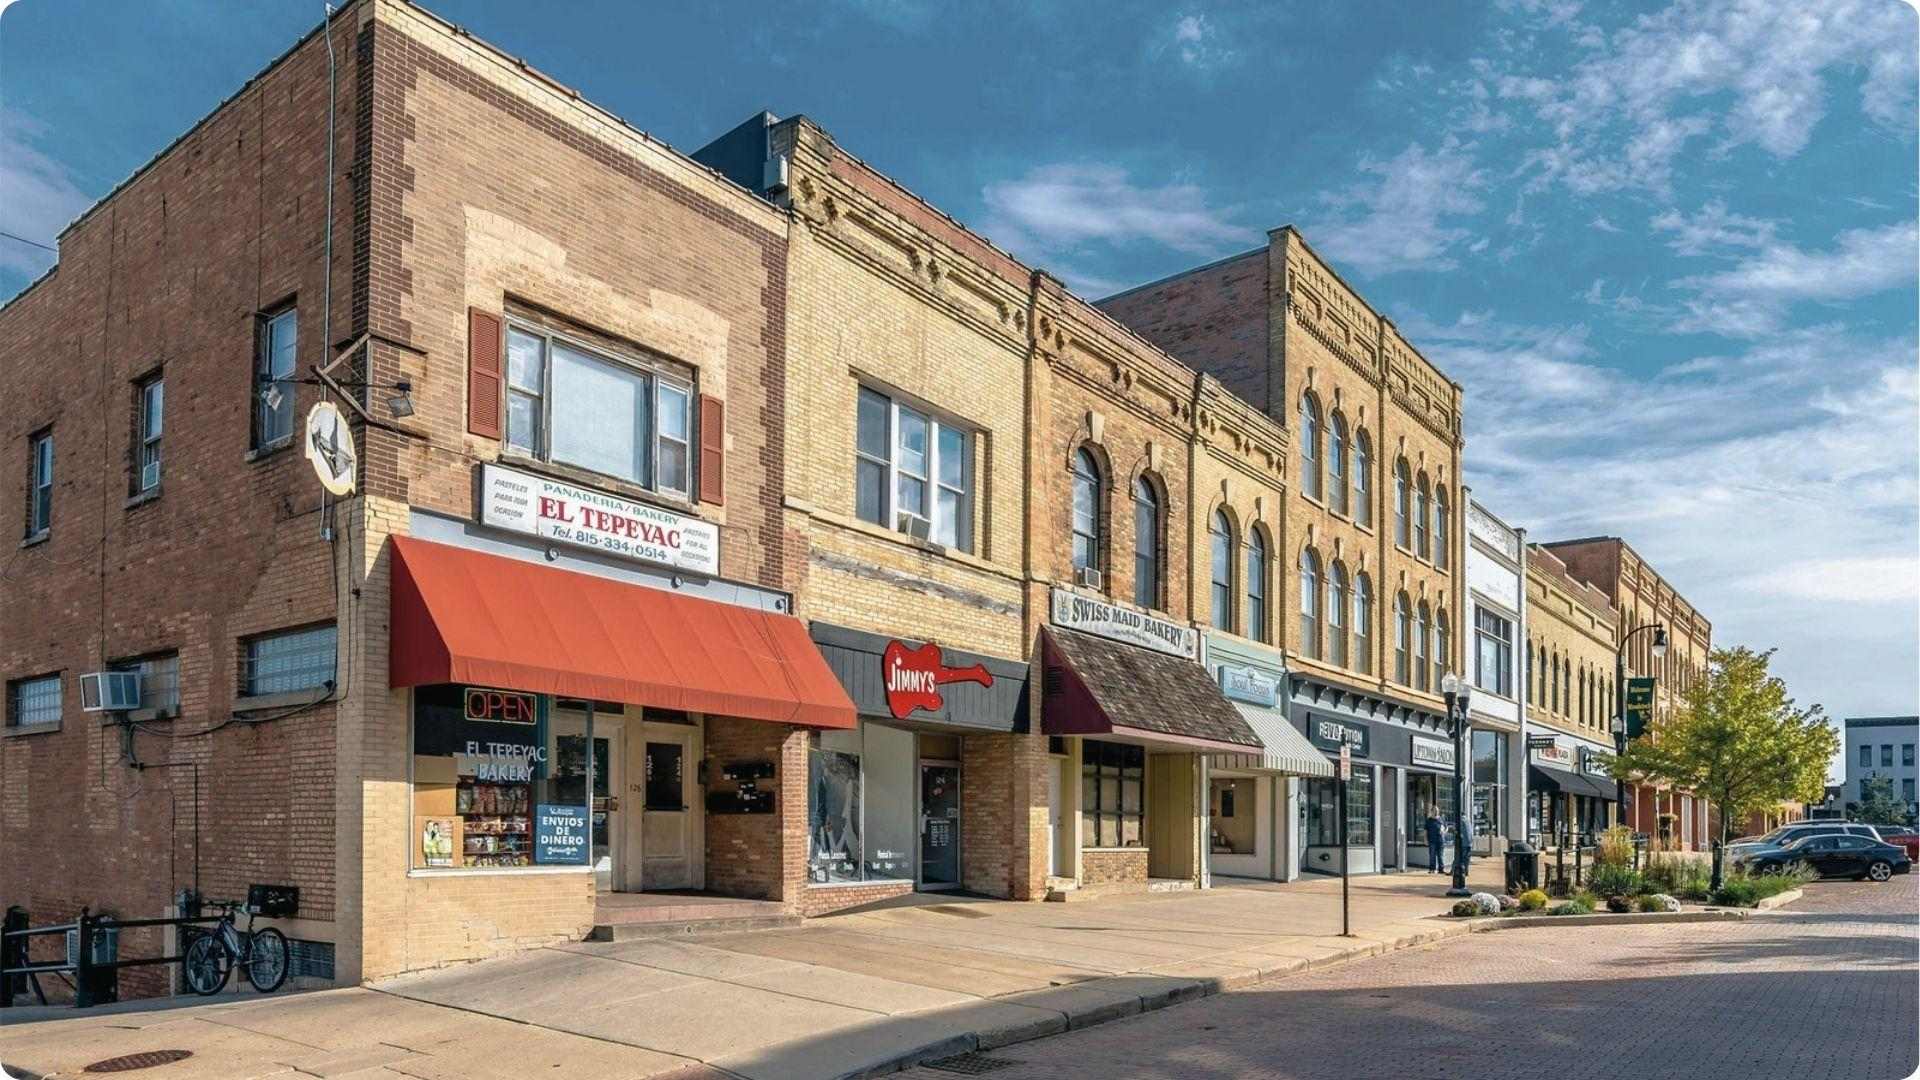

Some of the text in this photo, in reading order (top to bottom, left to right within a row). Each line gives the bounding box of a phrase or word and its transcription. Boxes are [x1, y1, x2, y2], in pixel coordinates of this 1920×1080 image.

[538, 495, 681, 549] EL TEPEYAC
[552, 525, 572, 539] Tel.
[1072, 597, 1110, 623] SWISS
[1111, 608, 1141, 629] MAID
[1144, 620, 1184, 648] BAKERY
[468, 691, 533, 721] OPEN
[466, 741, 547, 762] EL TEPEYAC
[479, 763, 534, 782] BAKERY
[540, 835, 584, 846] DINERO
[556, 826, 570, 836] DE
